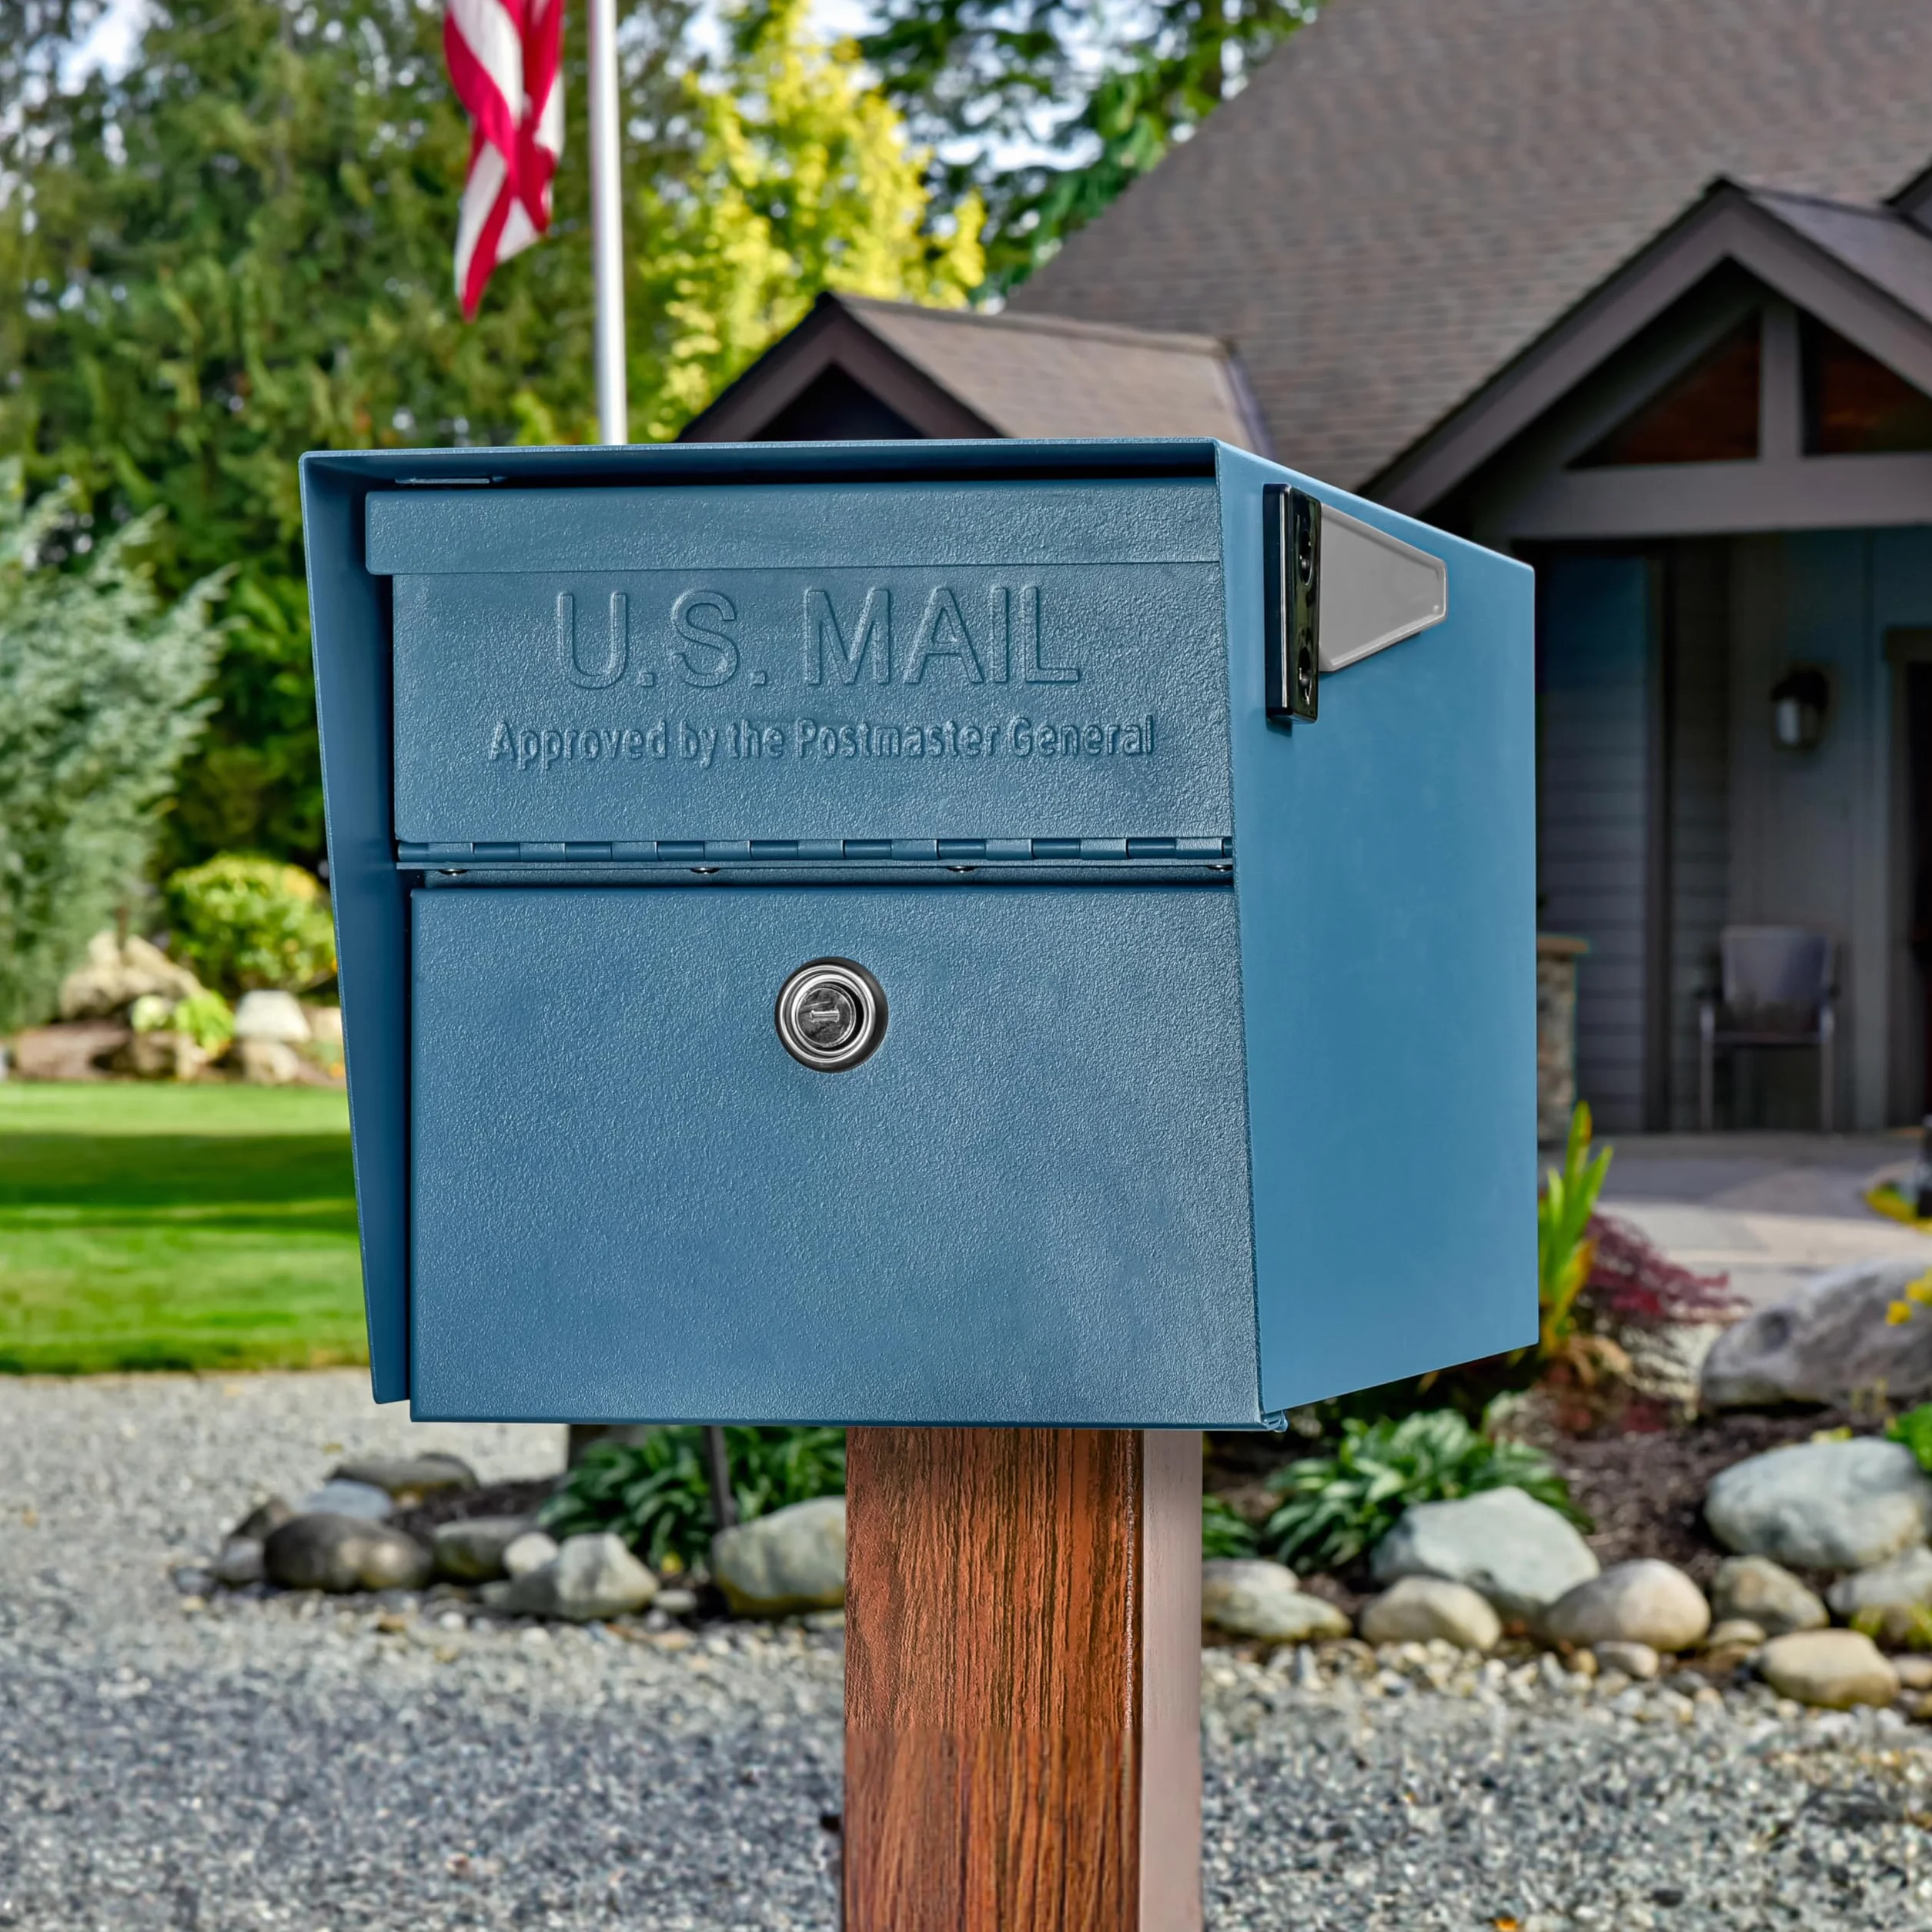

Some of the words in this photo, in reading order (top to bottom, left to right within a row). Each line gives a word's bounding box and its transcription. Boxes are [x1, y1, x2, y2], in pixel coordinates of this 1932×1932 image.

[557, 590, 767, 689] U.S.
[802, 587, 1081, 684] MAIL
[488, 720, 667, 770] Approved
[680, 720, 717, 768] by
[728, 719, 784, 758] the
[795, 717, 999, 757] Postmaster
[1010, 715, 1153, 755] General
